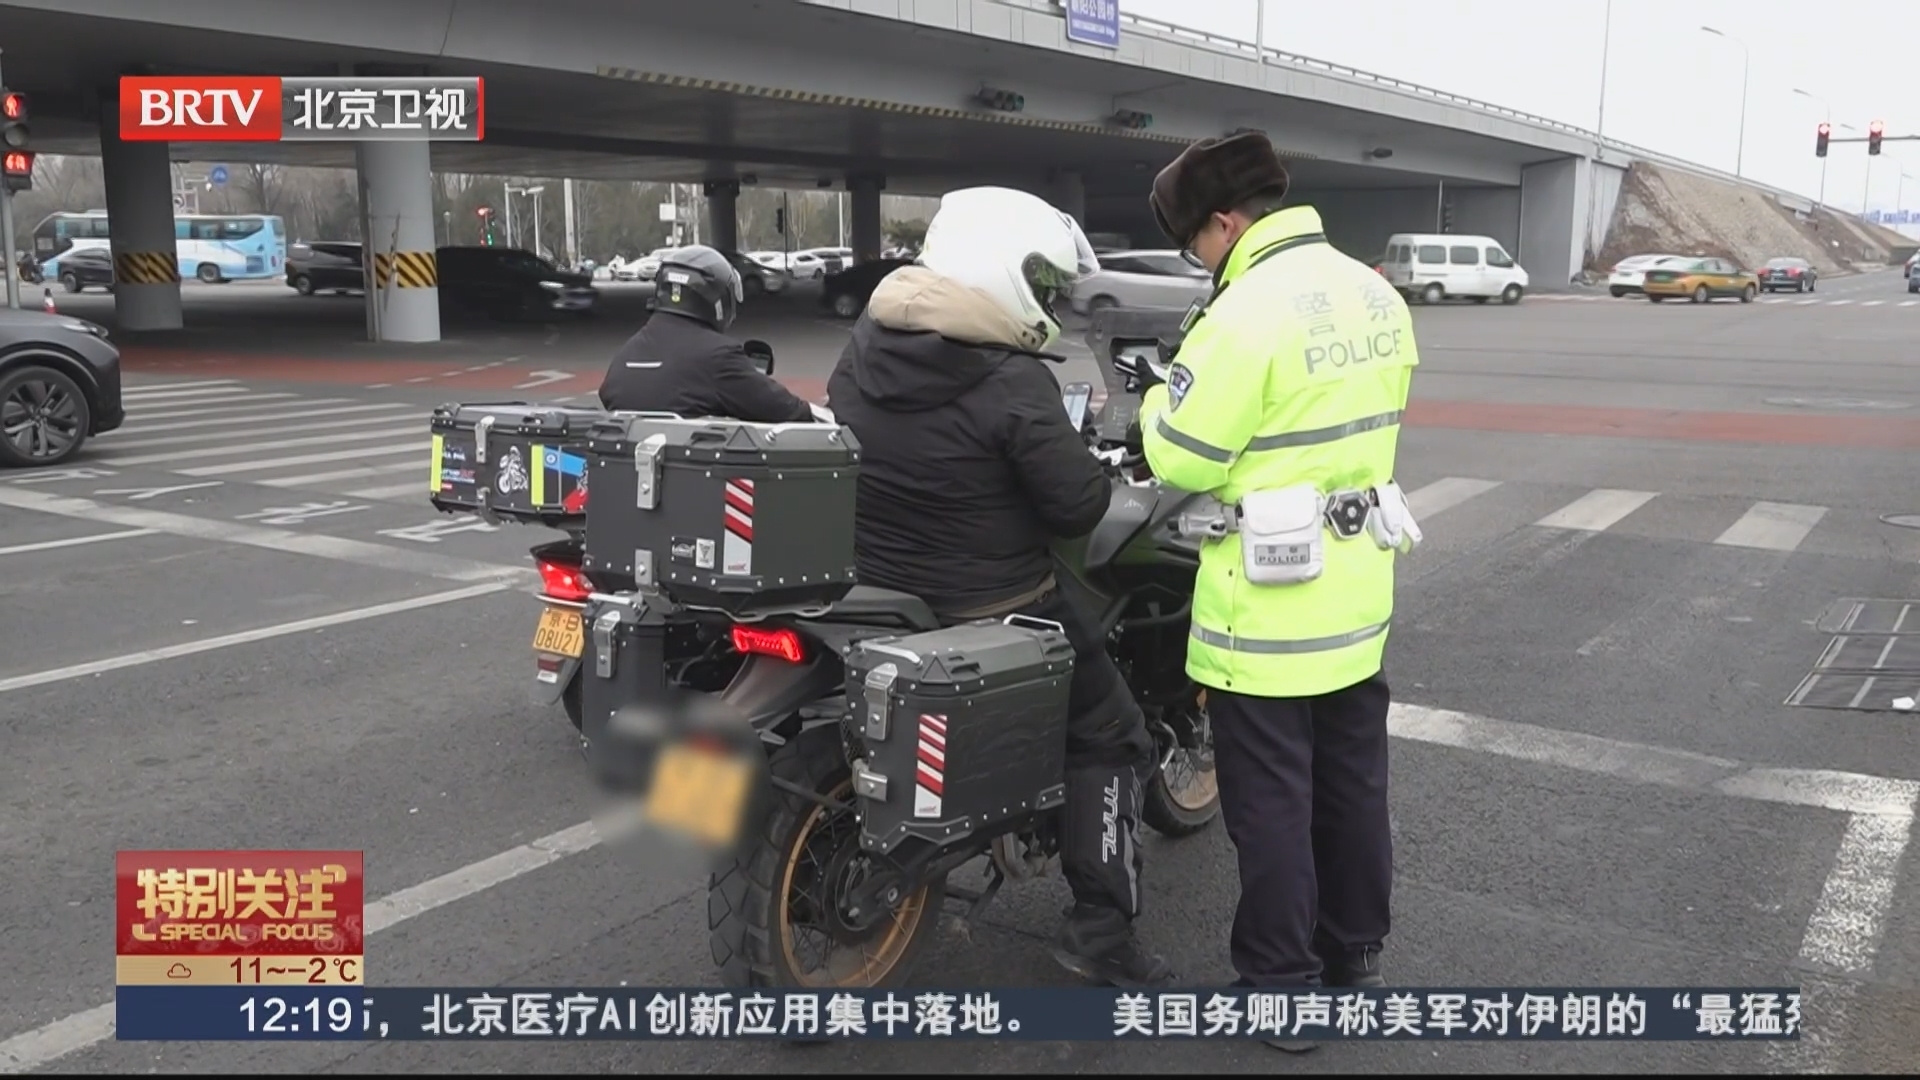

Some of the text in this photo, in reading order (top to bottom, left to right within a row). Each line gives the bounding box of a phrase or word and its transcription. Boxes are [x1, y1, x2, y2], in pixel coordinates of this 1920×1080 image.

[1294, 281, 1399, 338] 警察
[1304, 329, 1402, 375] POLICE
[1258, 555, 1307, 564] POLICE
